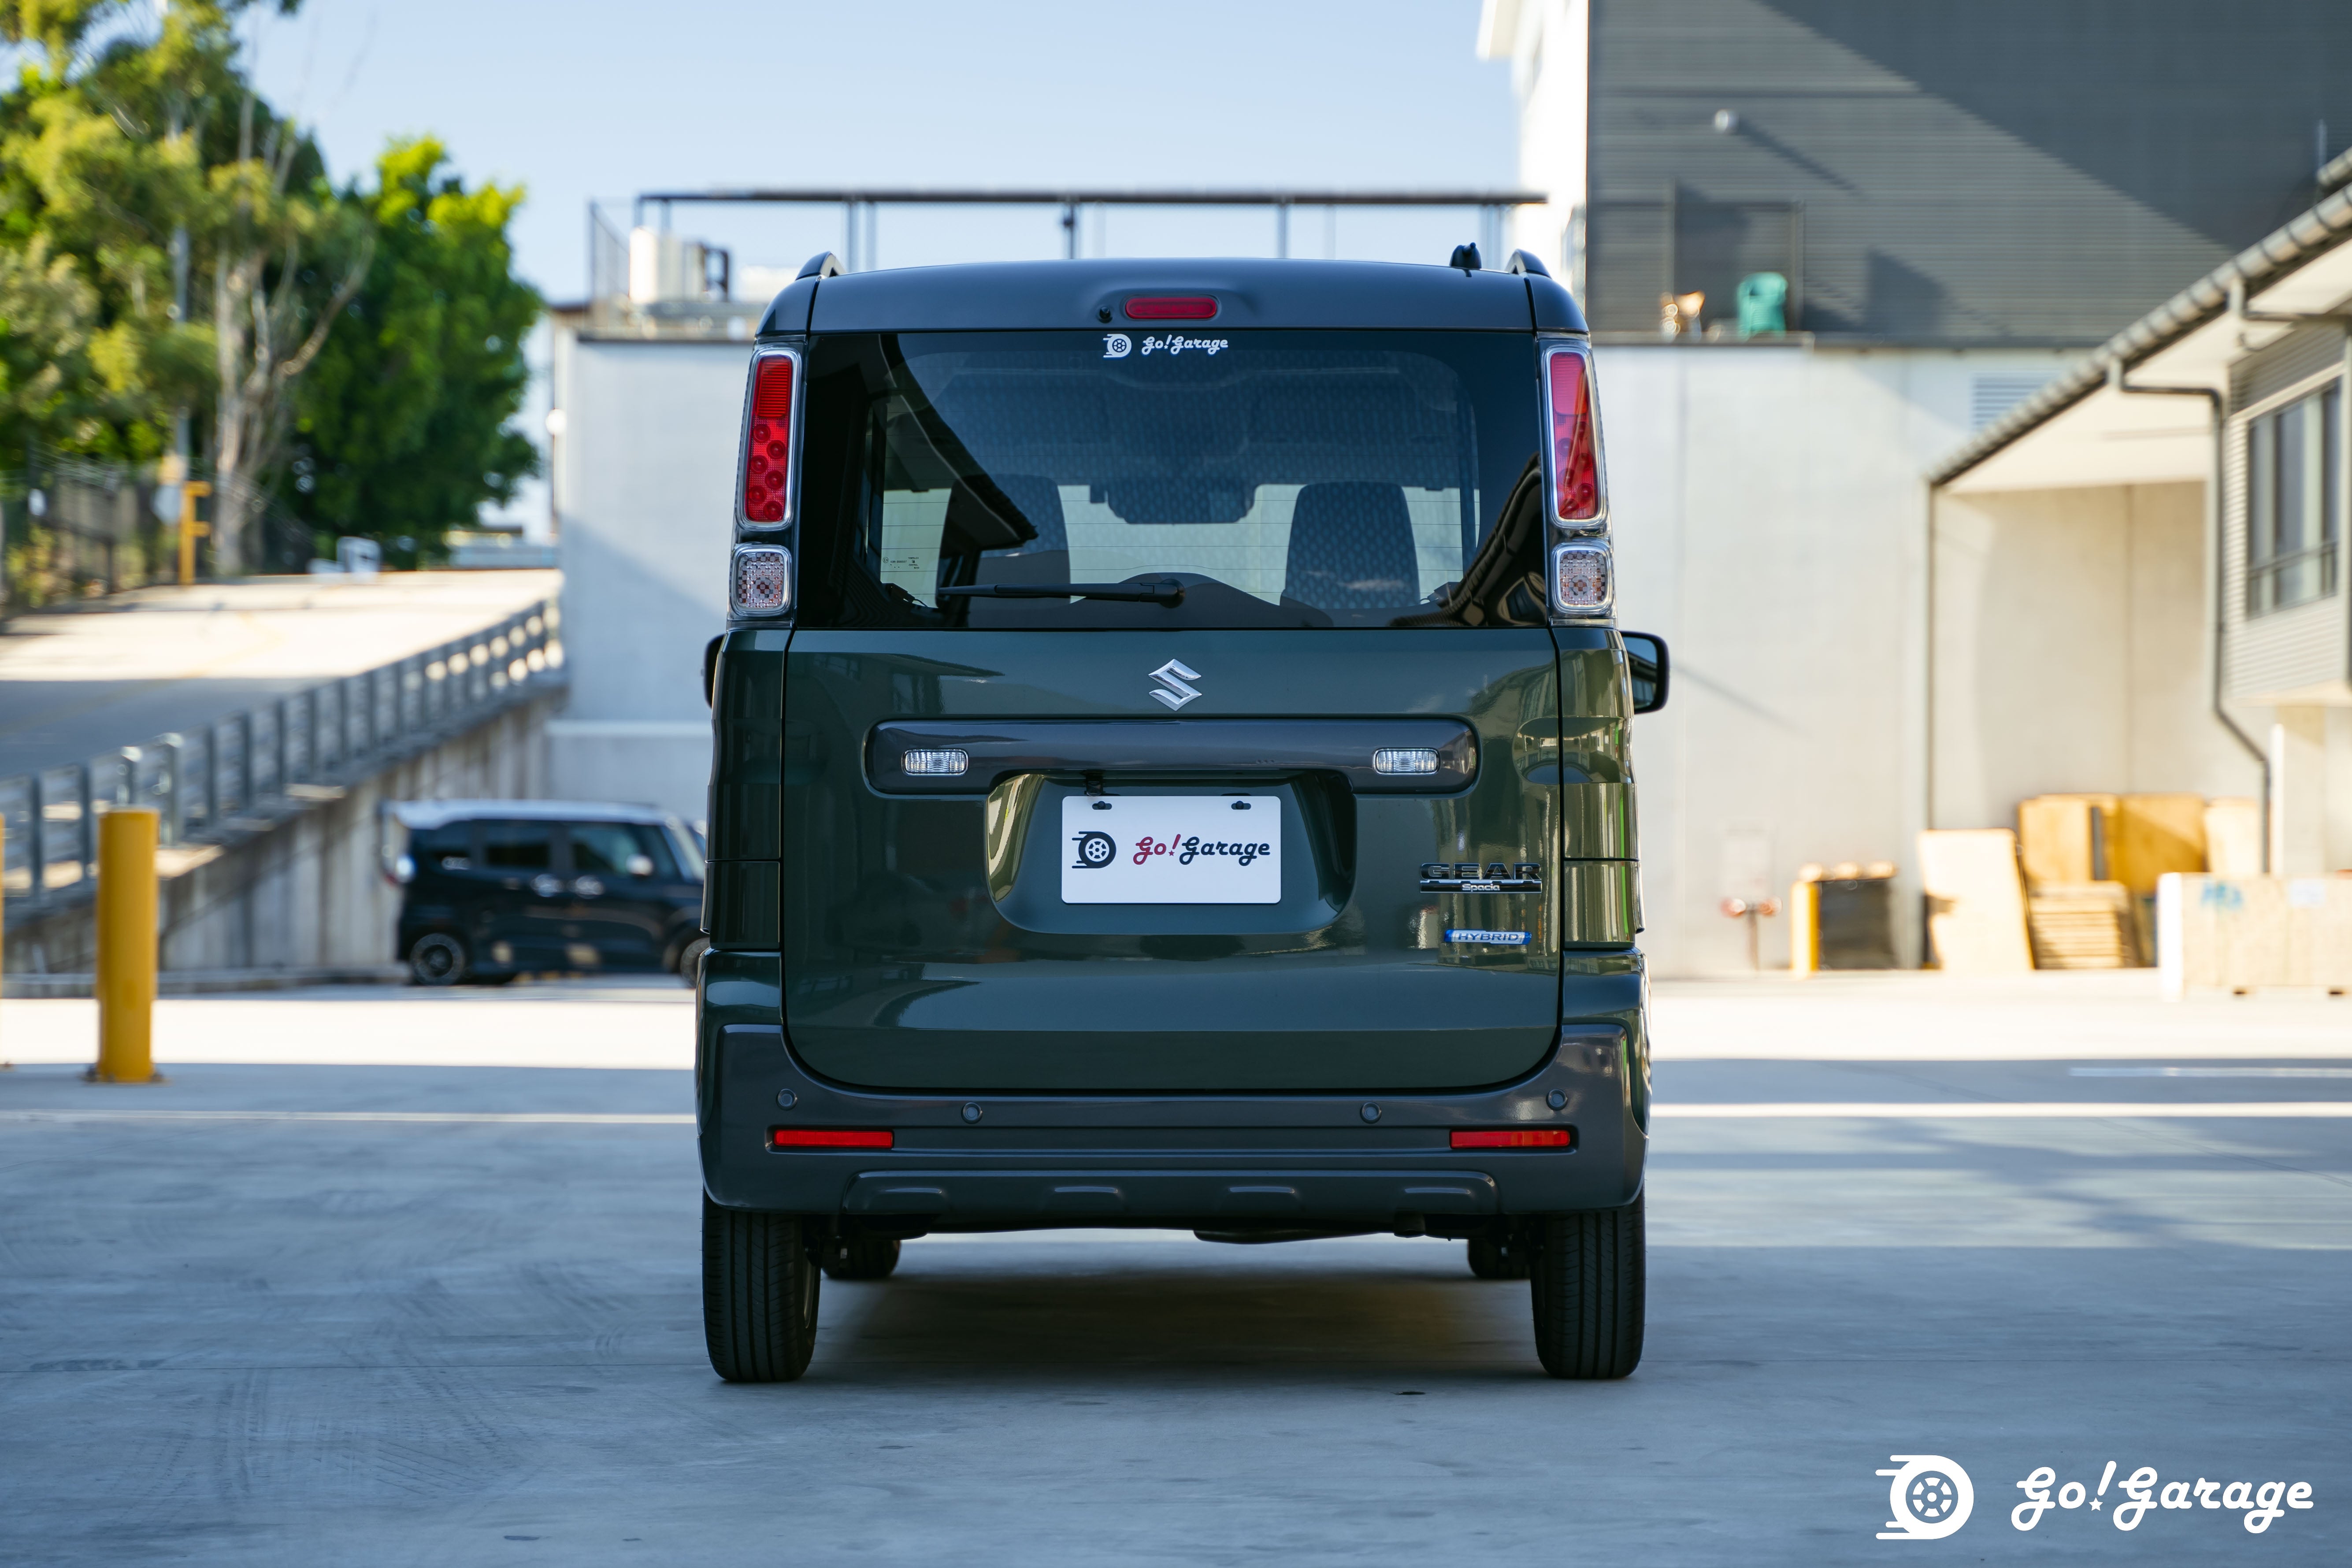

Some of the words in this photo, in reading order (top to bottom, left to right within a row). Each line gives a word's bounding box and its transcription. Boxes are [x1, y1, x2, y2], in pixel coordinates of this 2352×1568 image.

[1420, 863, 1542, 881] GEAR
[1462, 884, 1500, 892] Spacia
[1458, 933, 1519, 941] HYBRID
